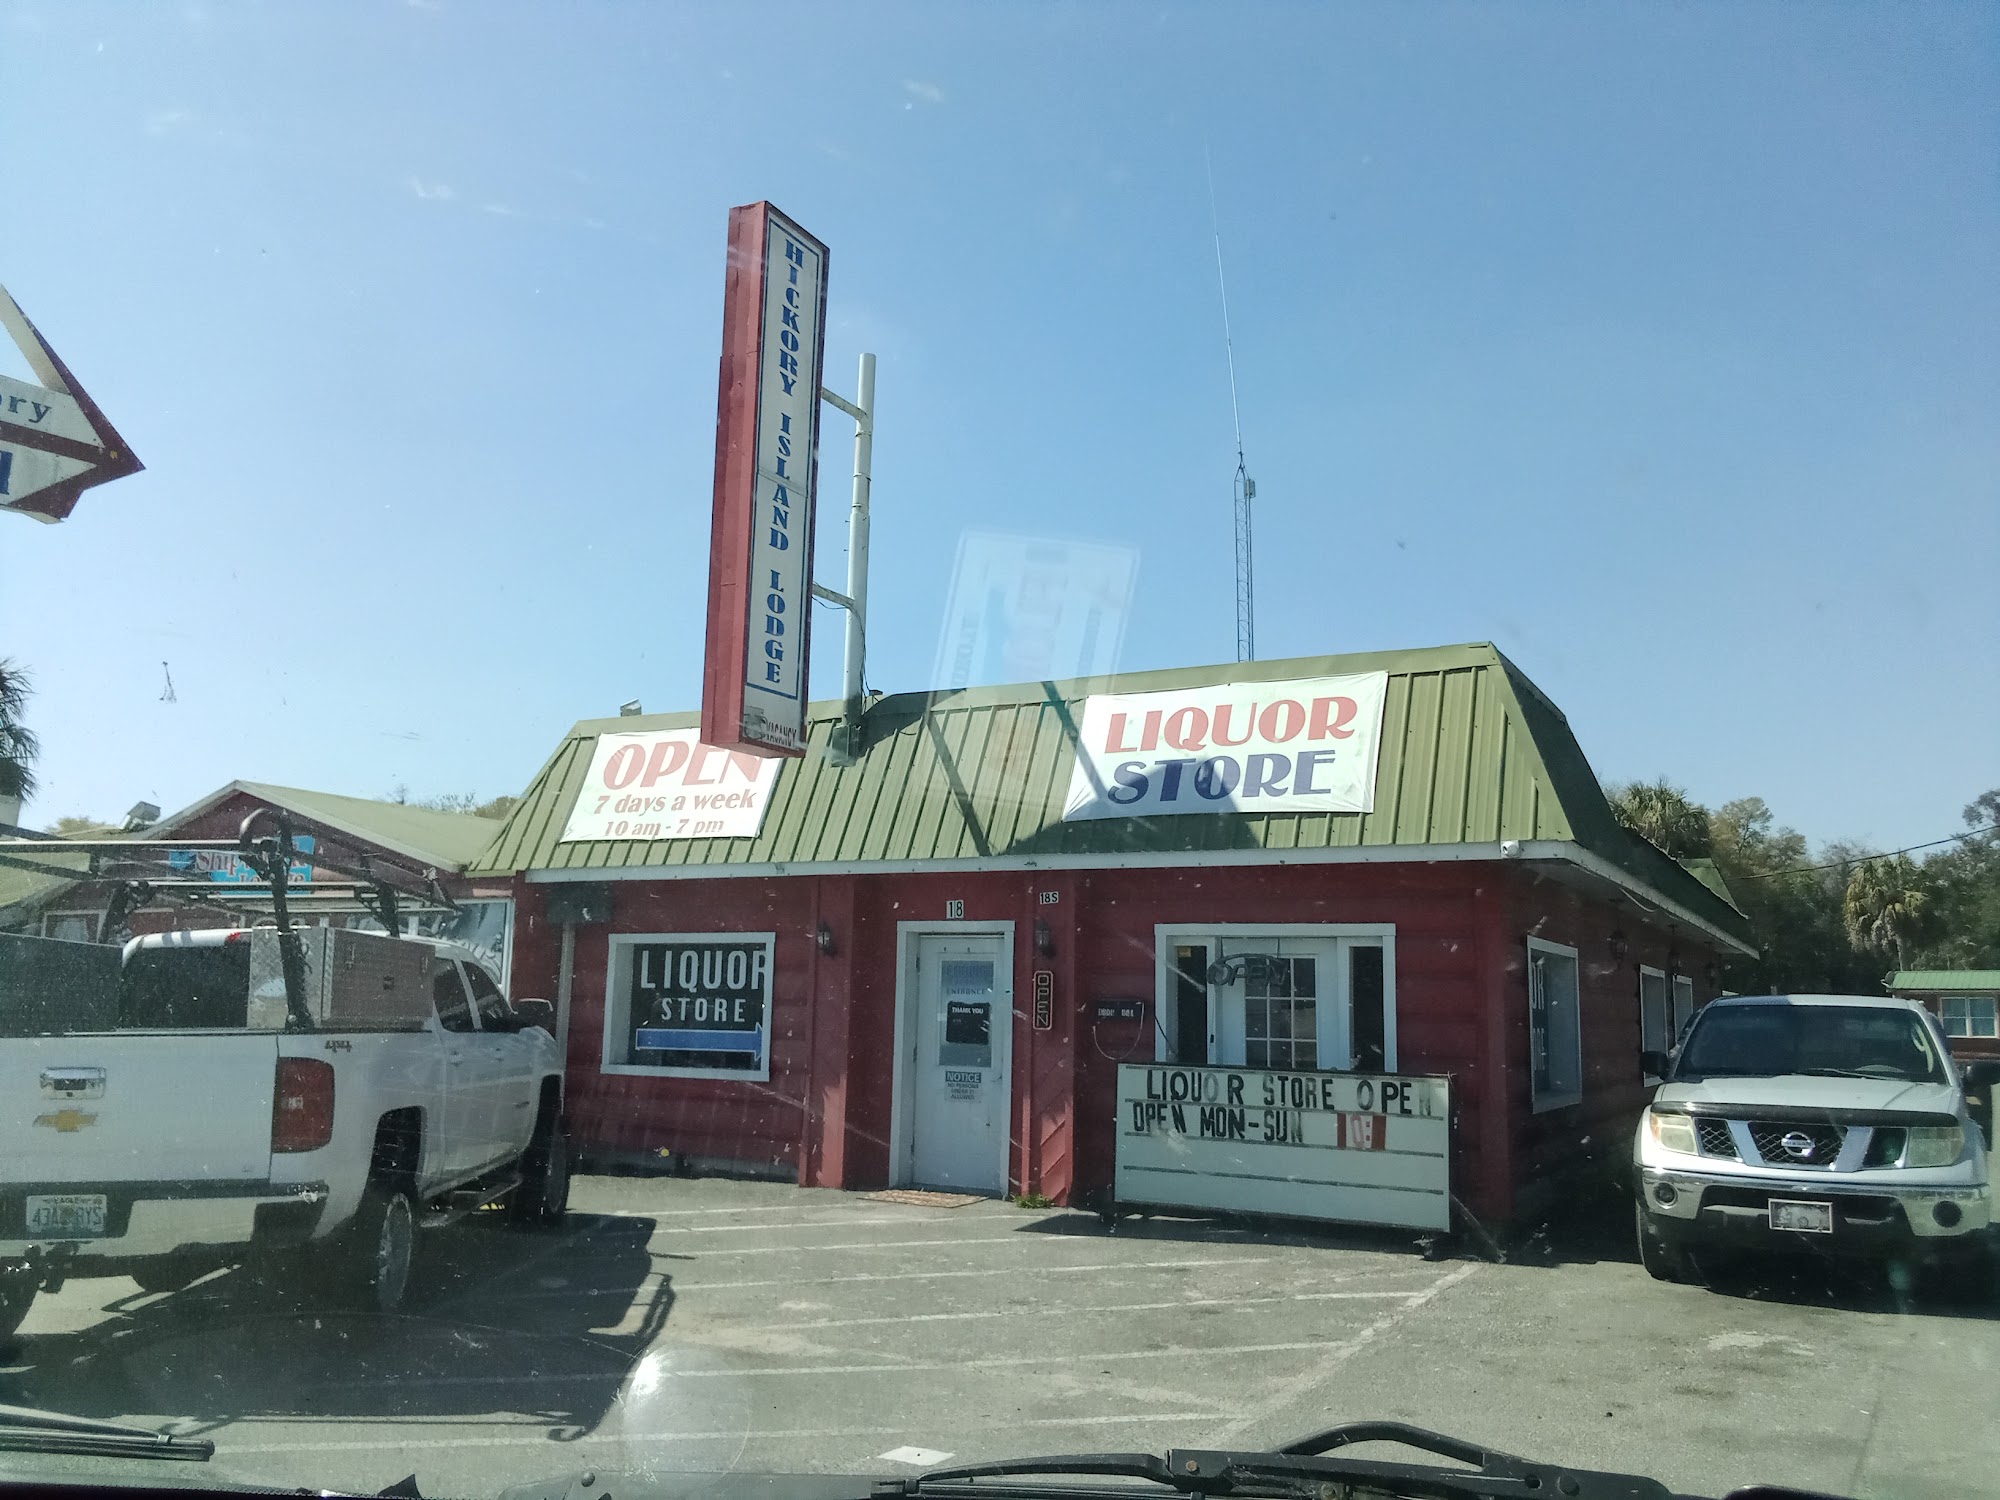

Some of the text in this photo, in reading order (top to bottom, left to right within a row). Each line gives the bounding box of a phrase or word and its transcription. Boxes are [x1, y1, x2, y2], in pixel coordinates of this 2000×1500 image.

[764, 238, 805, 684] HICKORY ISLAND LODGE
[1105, 696, 1358, 754] LIQUOR
[603, 741, 763, 790] OPEN
[1107, 750, 1336, 805] STORE
[593, 788, 757, 817] 7 days a week
[604, 820, 629, 837] 10
[630, 822, 661, 839] am
[677, 818, 690, 834] 7
[692, 820, 725, 837] pm
[948, 900, 963, 918] 18
[1040, 892, 1059, 904] 18S
[640, 949, 767, 993] LIQUOR
[1206, 957, 1288, 987] OPEN
[661, 997, 747, 1022] STORE
[1036, 974, 1050, 1027] OPEN
[946, 1072, 981, 1083] NOTICE
[1146, 1069, 1245, 1105] LIQUOR
[1262, 1074, 1335, 1111] STORE
[1132, 1101, 1187, 1134] OPEN
[1200, 1105, 1303, 1143] MON-SUN
